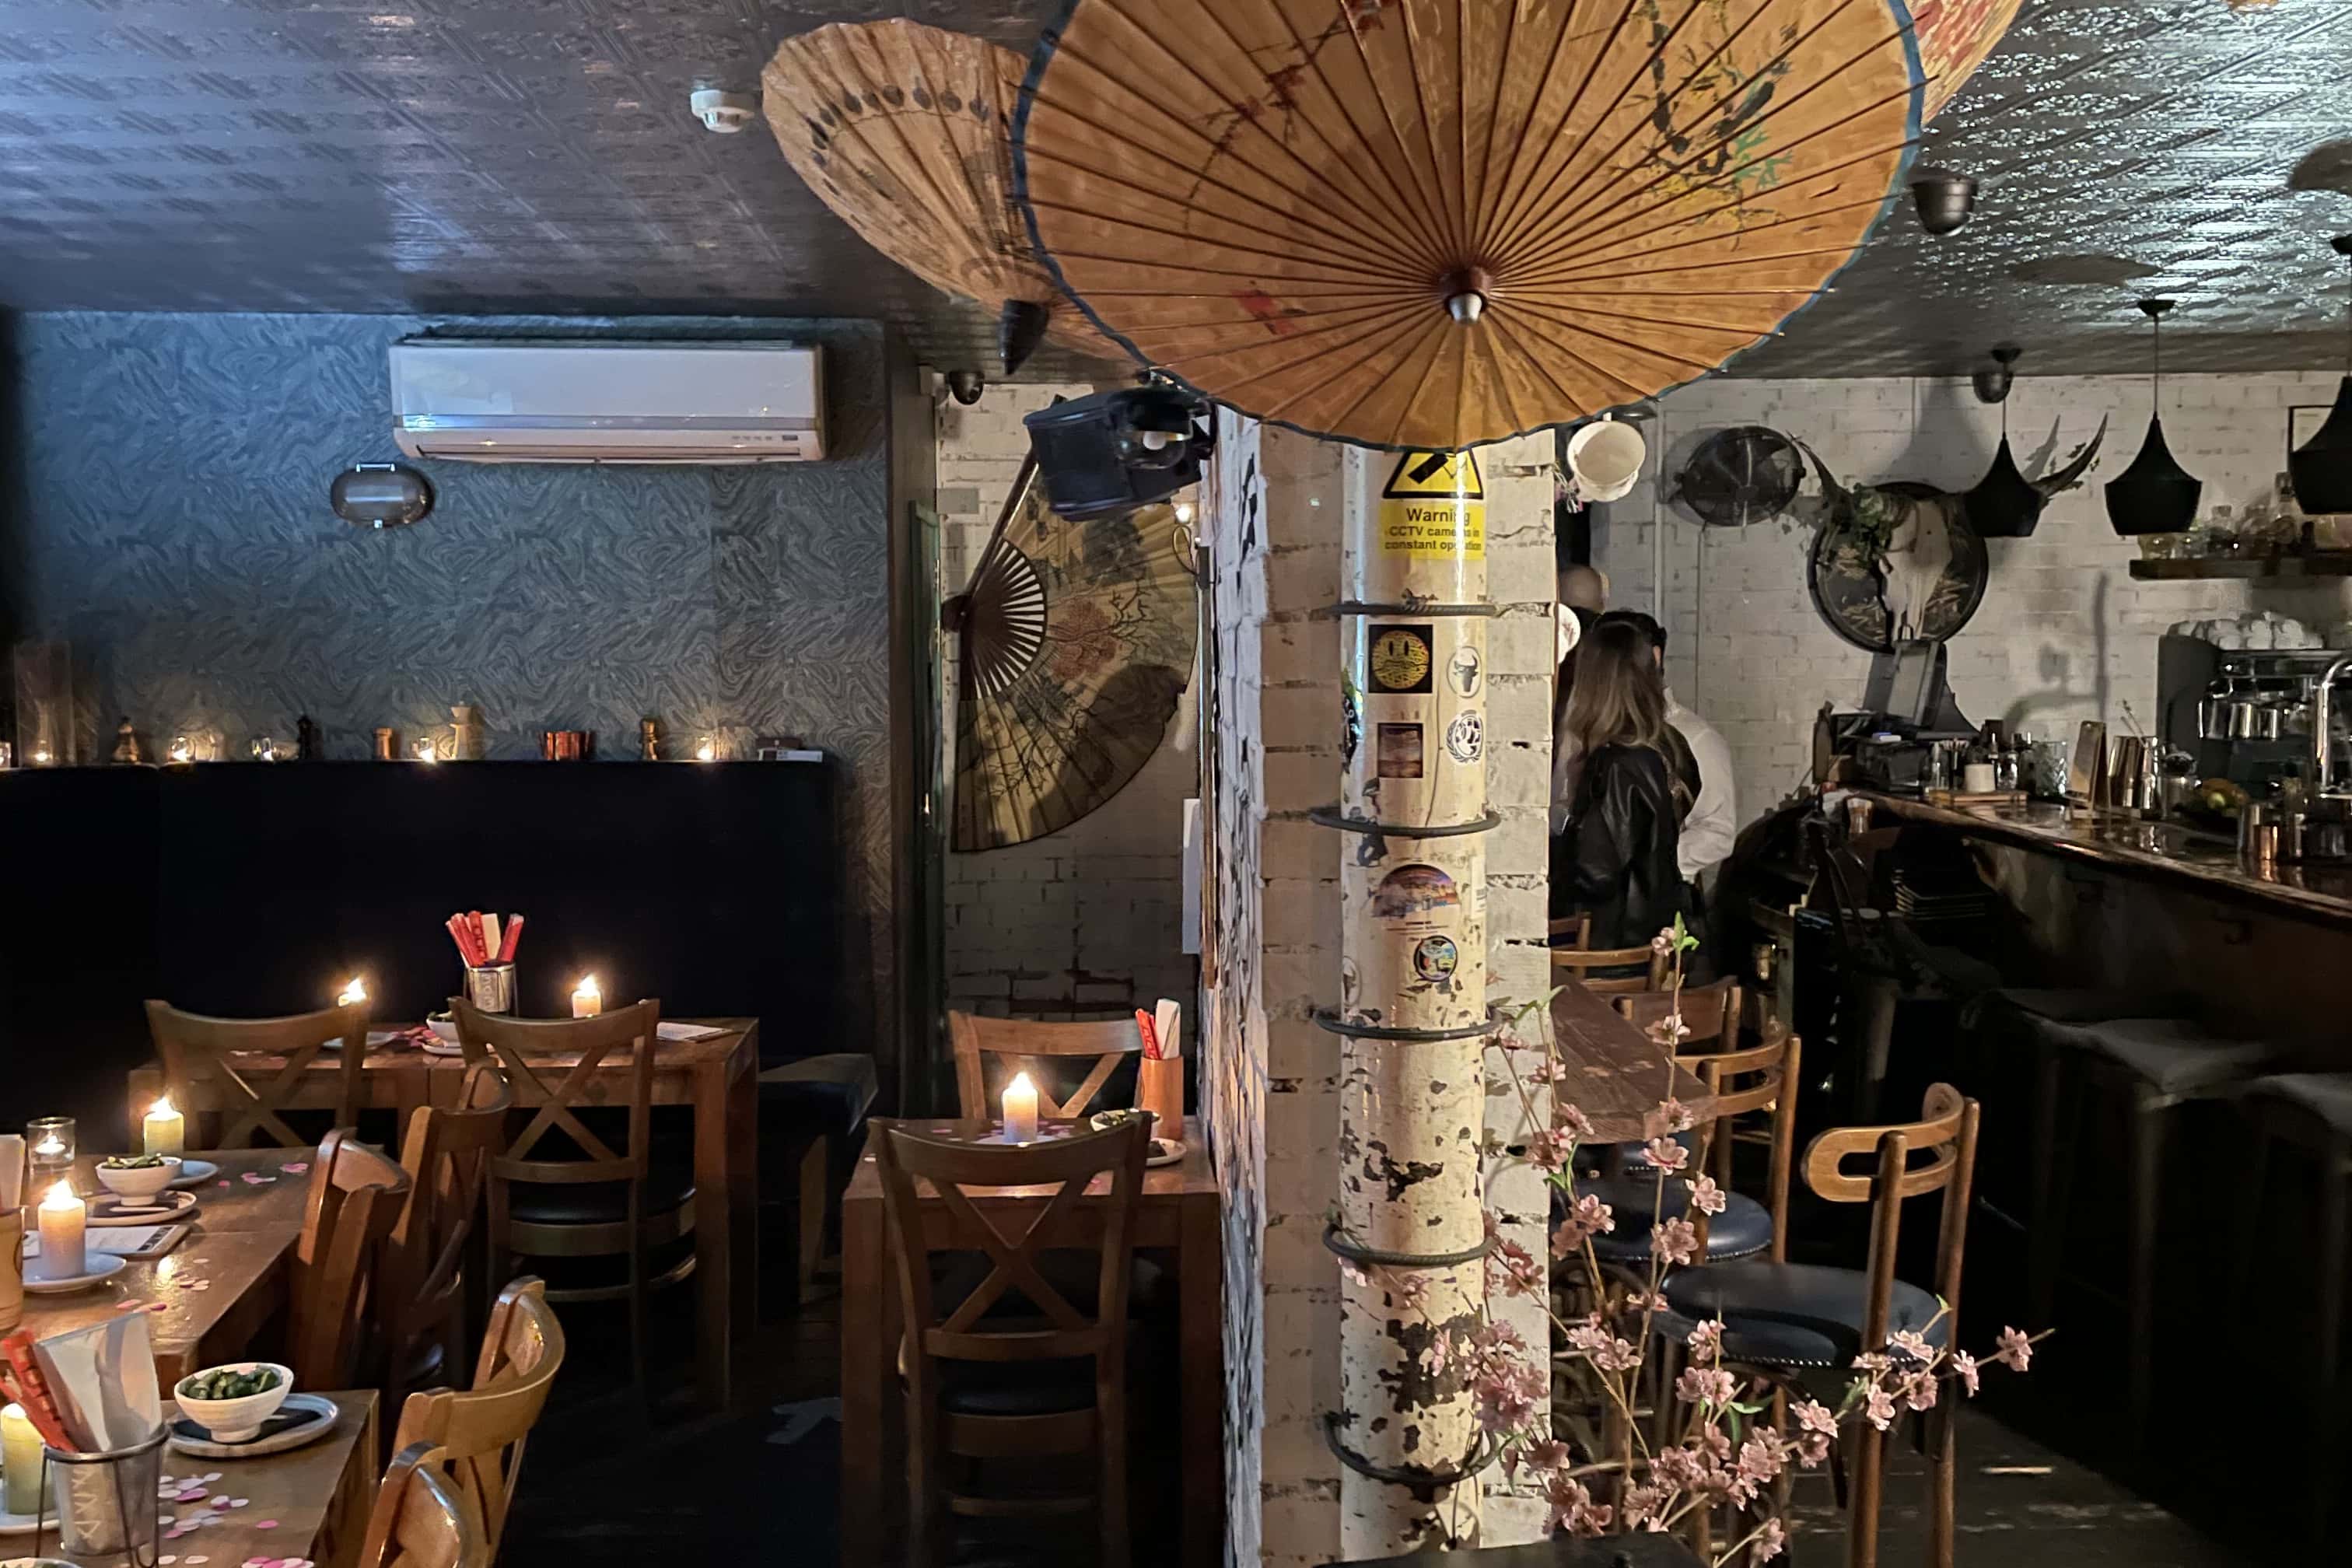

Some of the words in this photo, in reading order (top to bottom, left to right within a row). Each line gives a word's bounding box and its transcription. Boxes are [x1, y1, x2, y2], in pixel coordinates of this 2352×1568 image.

[1406, 508, 1470, 526] Warnig
[1388, 526, 1423, 536] CCTV
[1427, 528, 1471, 537] cameas
[1384, 540, 1437, 549] constant
[1440, 540, 1481, 551] opation
